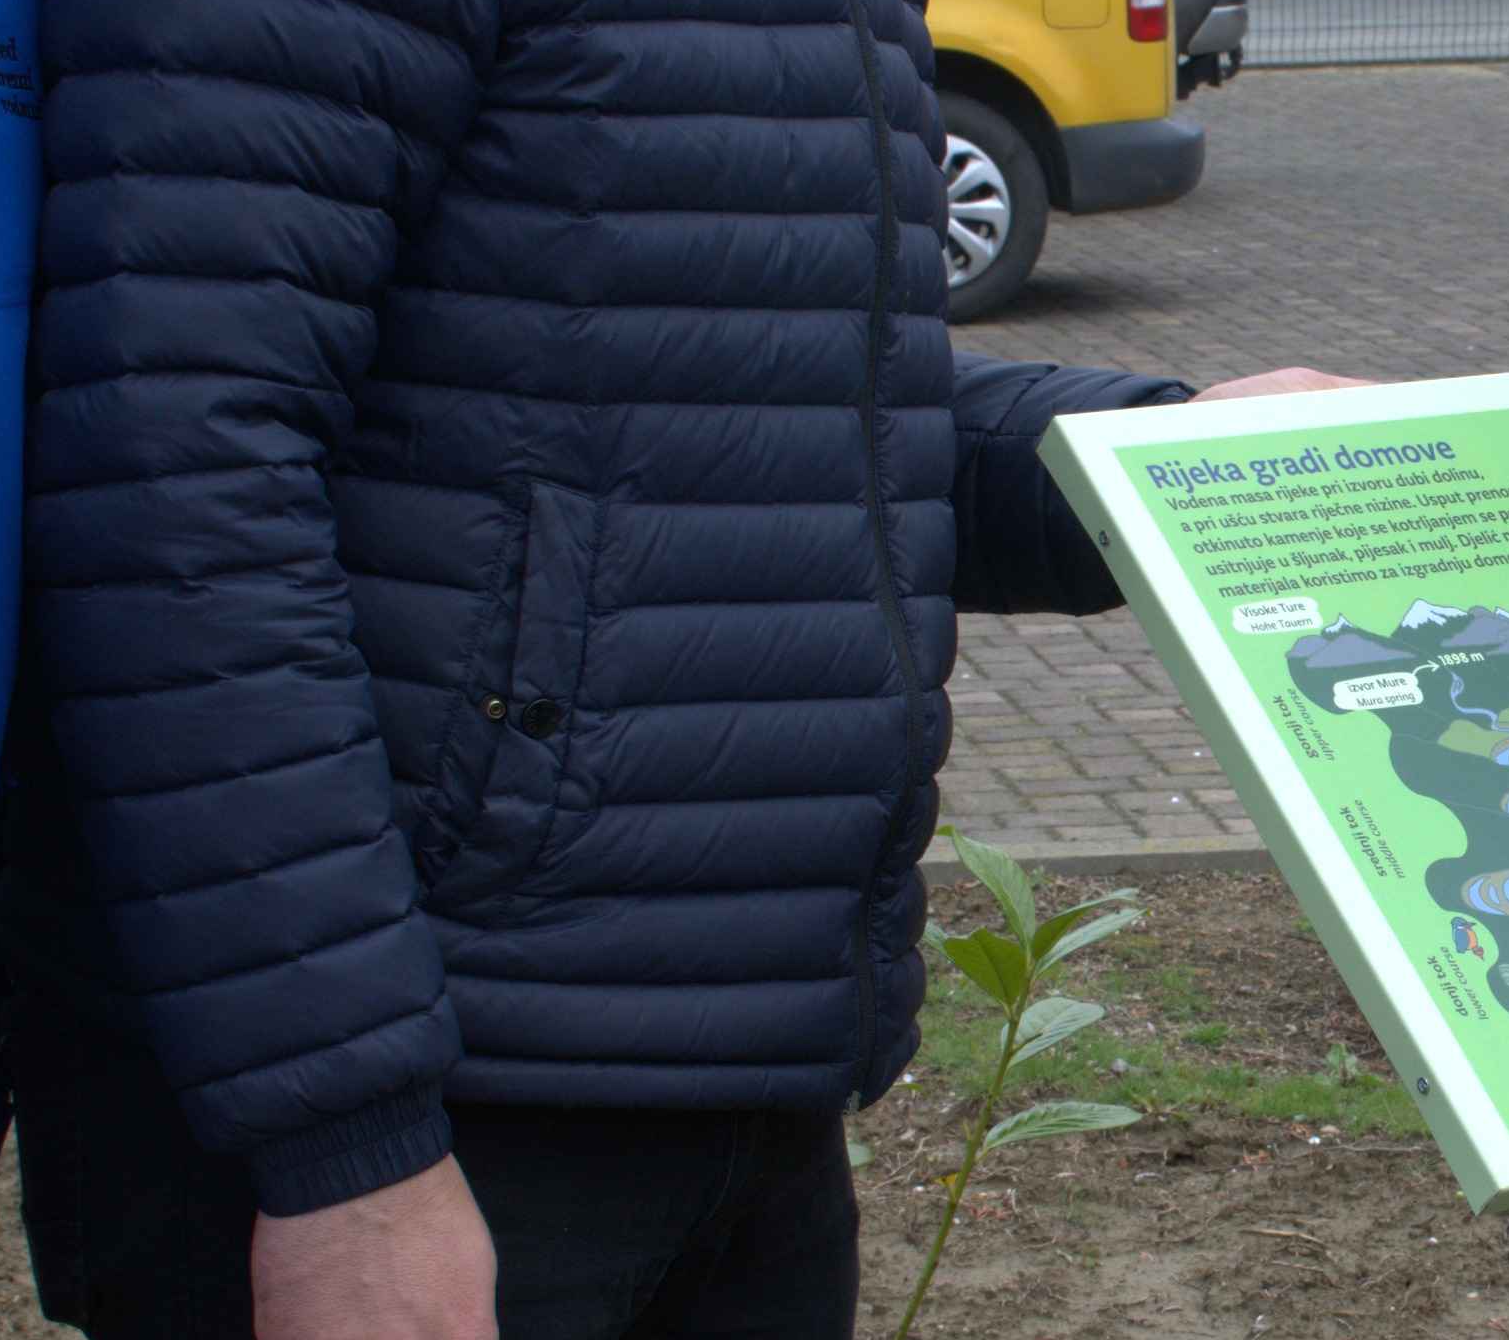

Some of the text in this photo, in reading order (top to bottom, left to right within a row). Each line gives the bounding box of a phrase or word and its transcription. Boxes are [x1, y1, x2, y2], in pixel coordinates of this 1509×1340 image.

[1145, 442, 1456, 496] Rijeka gradi domove
[1165, 468, 1485, 511] Vodena masa rijeke pri izvoru dubi dolinu,
[1180, 522, 1193, 532] a
[1193, 516, 1217, 535] pri
[1218, 512, 1257, 528] ušću
[1259, 510, 1310, 524] stvara
[1311, 502, 1364, 521] riječne
[1365, 497, 1417, 513] nizine.
[1415, 491, 1465, 508] Usput
[1193, 536, 1263, 554] otkinuto
[1263, 527, 1333, 547] kamenje
[1332, 523, 1369, 540] koje
[1369, 524, 1388, 535] se
[1388, 512, 1478, 532] kotrljanjem
[1478, 512, 1497, 522] se
[1205, 556, 1276, 576] usitnjuje
[1277, 557, 1291, 567] u
[1289, 548, 1353, 569] šljunak,
[1353, 541, 1409, 563] pijesak
[1407, 539, 1417, 553] i
[1418, 535, 1458, 552] mulj.
[1456, 529, 1502, 550] Djelić
[1218, 576, 1301, 598] materijala
[1299, 569, 1378, 588] koristimo
[1379, 568, 1400, 579] za
[1397, 556, 1473, 579] izgradnju
[1239, 601, 1306, 617] Visoke Ture
[1250, 617, 1313, 632] Hohe Tauern
[1437, 651, 1485, 667] 1898 m
[1348, 676, 1407, 693] izvor Mure
[1356, 691, 1416, 707] Mura spring
[1272, 695, 1320, 759] gornji tok
[1310, 727, 1335, 761] upper
[1354, 799, 1381, 837] course
[1339, 806, 1388, 877] srednji tok
[1426, 955, 1469, 1017] donji tok
